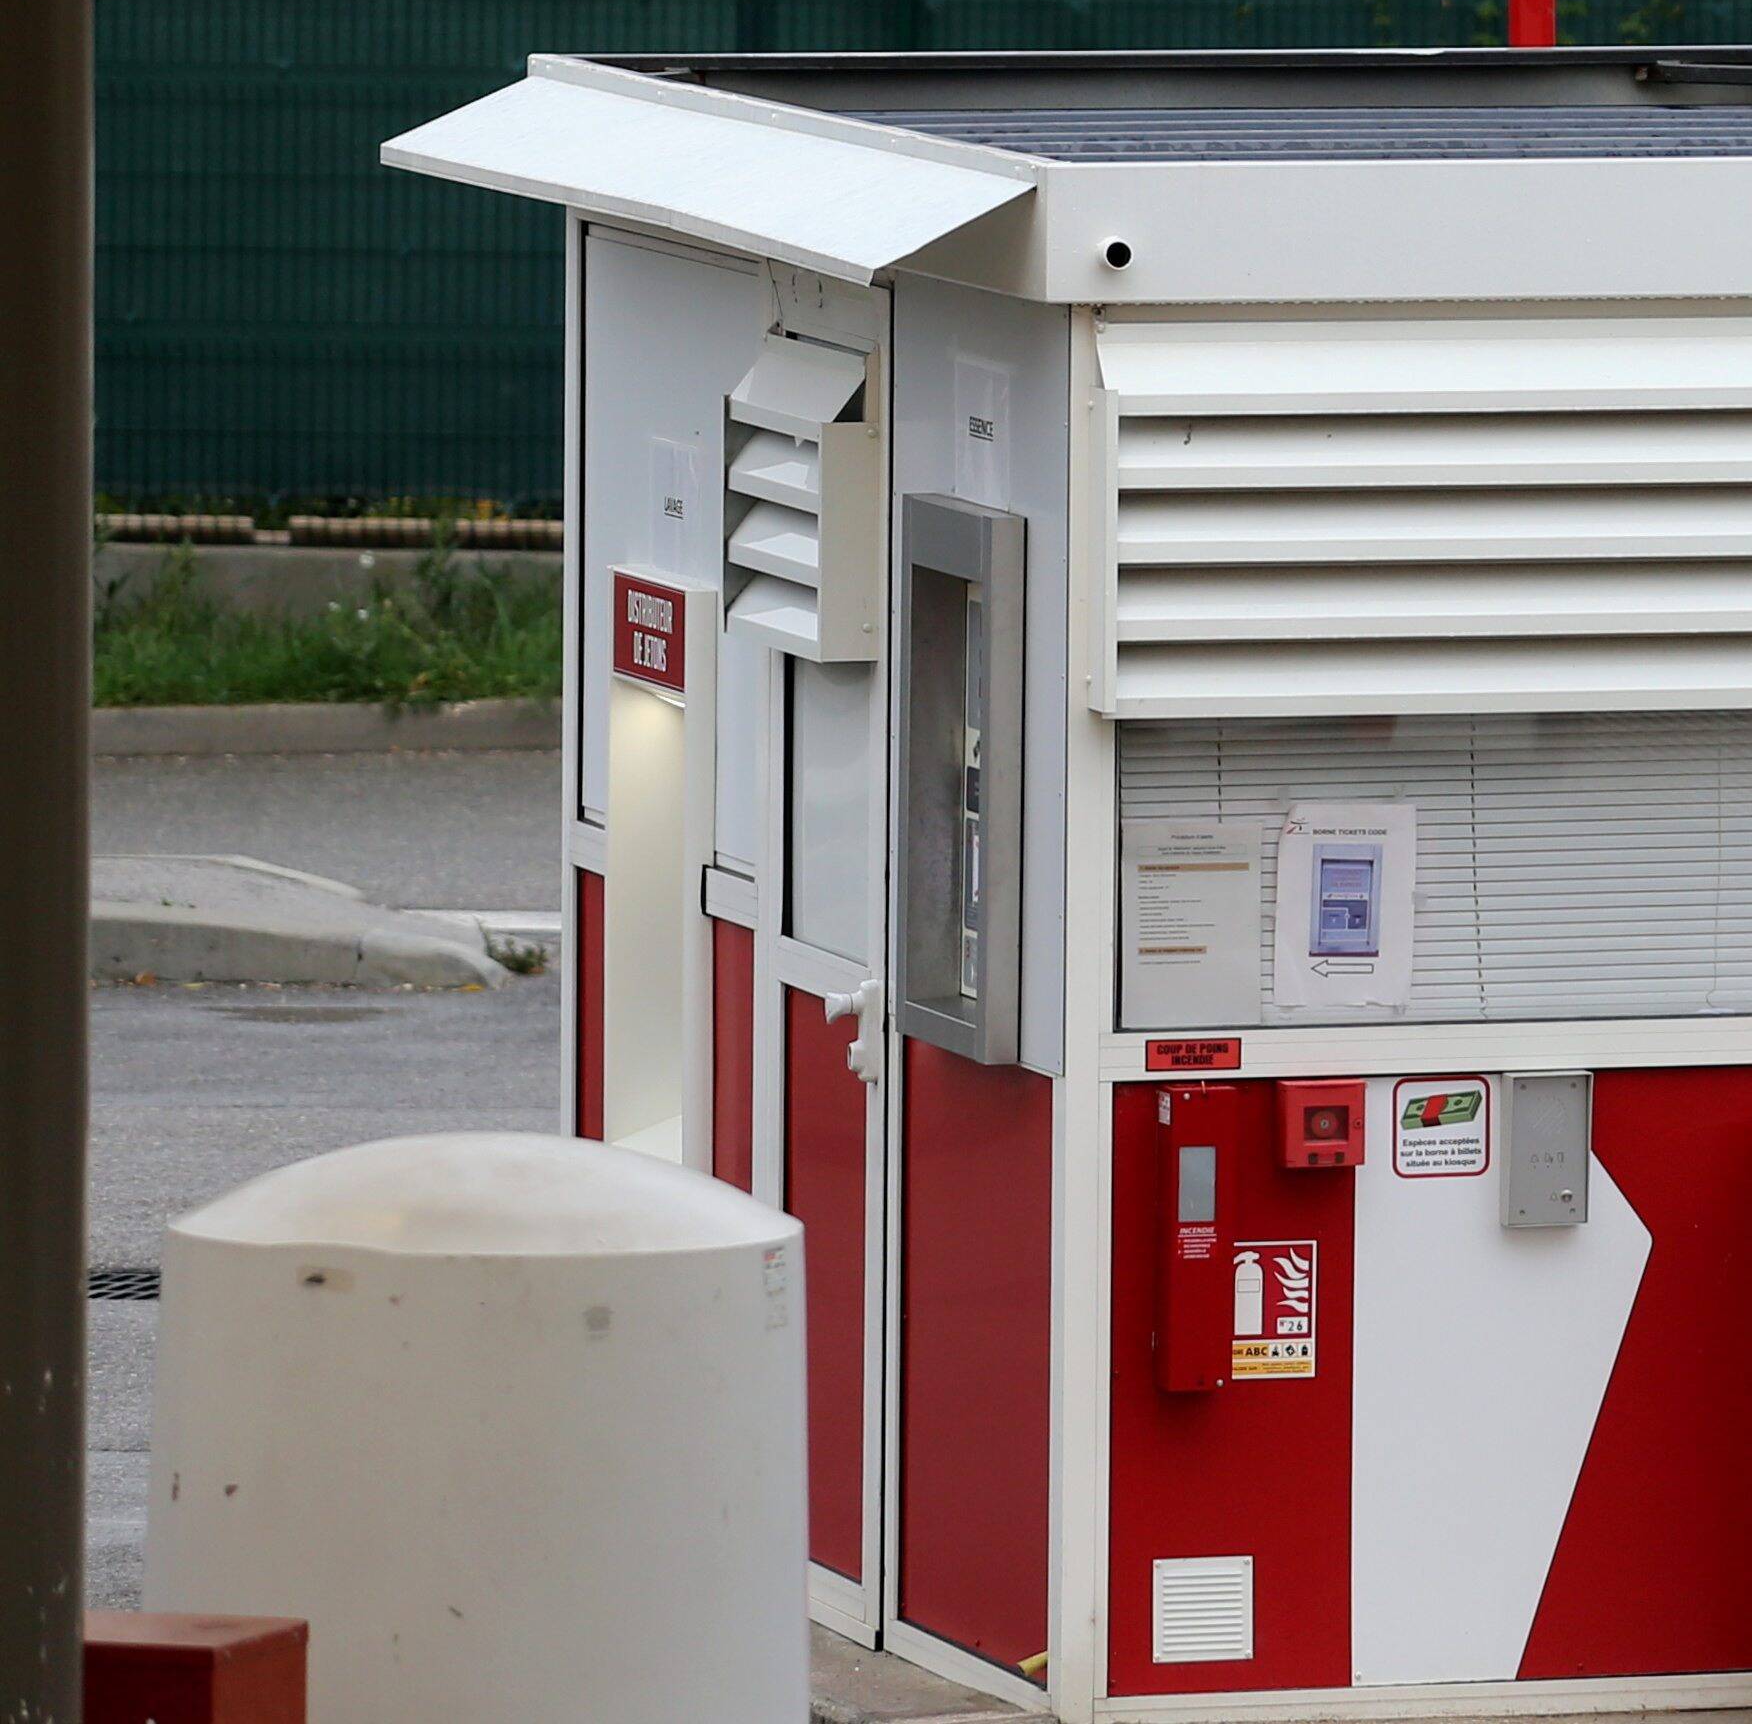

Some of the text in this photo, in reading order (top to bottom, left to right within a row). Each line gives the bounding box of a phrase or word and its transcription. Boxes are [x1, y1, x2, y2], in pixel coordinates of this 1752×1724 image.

[627, 588, 673, 636] DISTRIBUTEUR
[633, 630, 644, 664] DE
[1156, 1043, 1229, 1055] COUP DE POING
[1171, 1054, 1214, 1065] INCENDIE
[1402, 1139, 1437, 1147] Espèces
[1457, 1147, 1482, 1155] billets
[1179, 1227, 1216, 1236] INCENDIE
[1245, 1347, 1268, 1356] ABC
